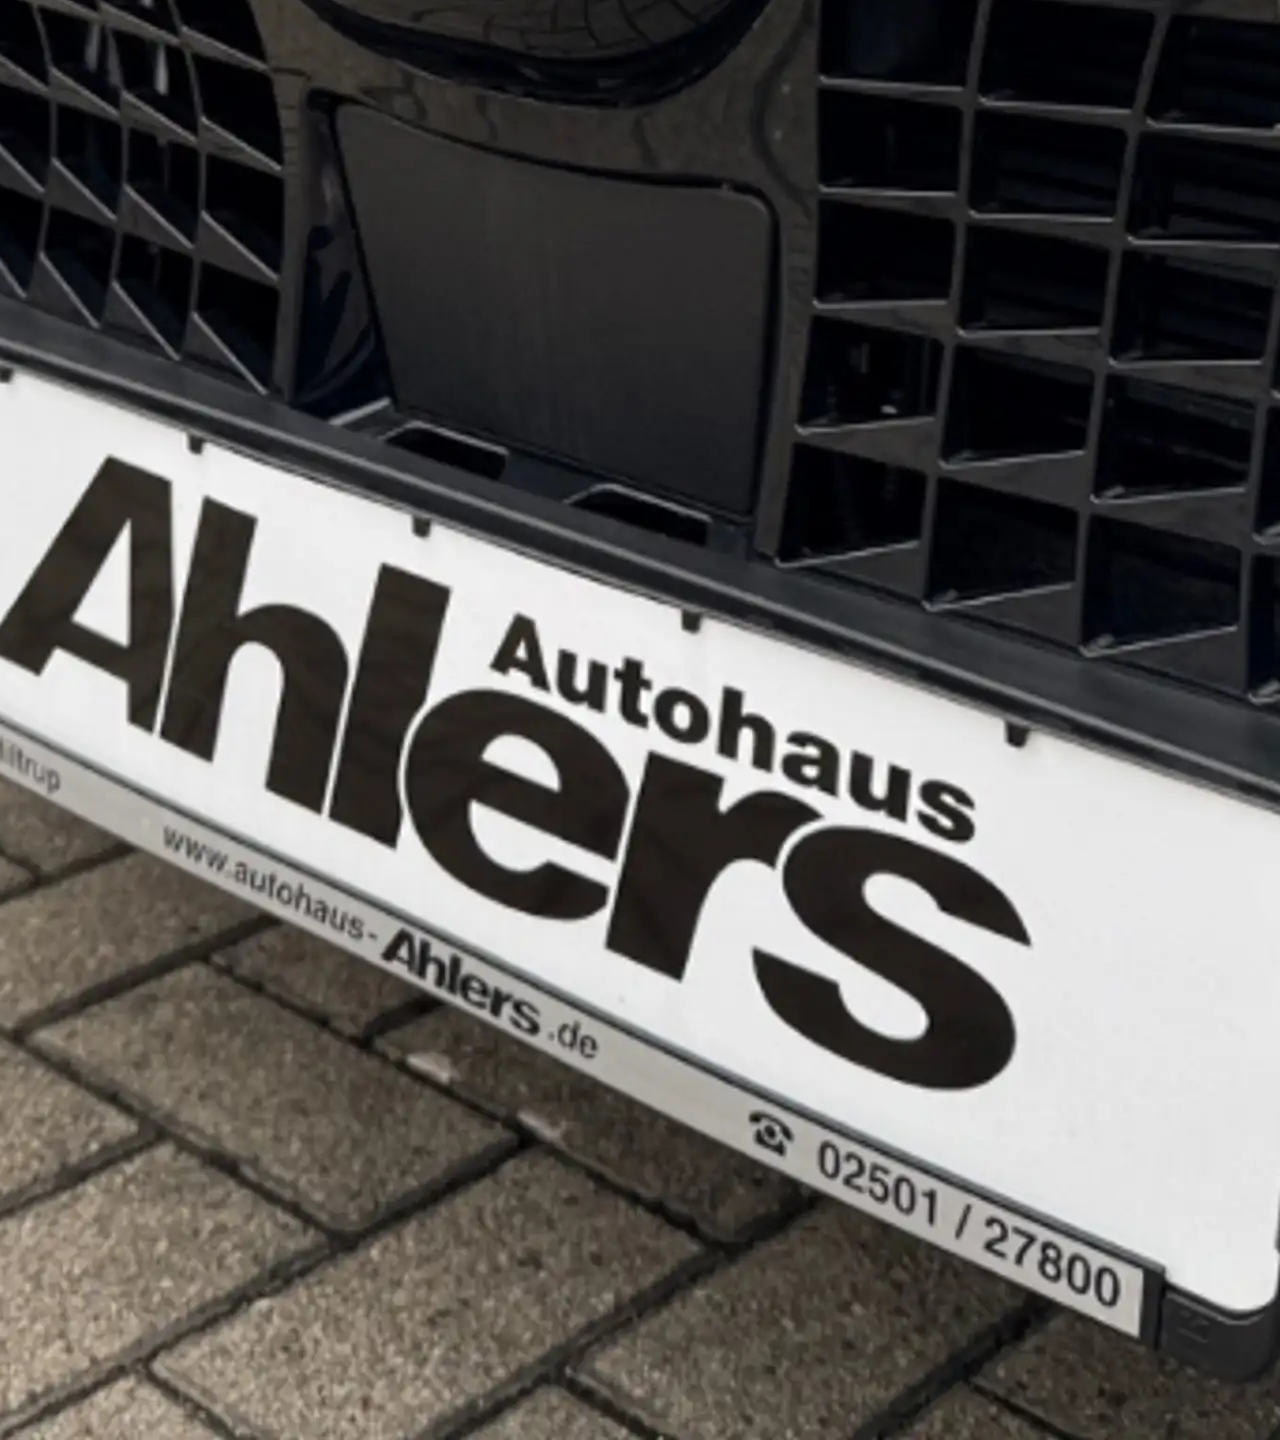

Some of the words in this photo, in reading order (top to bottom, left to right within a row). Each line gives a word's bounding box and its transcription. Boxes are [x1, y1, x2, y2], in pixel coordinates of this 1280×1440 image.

[491, 615, 974, 842] Autohaus
[818, 1140, 937, 1227] 02501
[954, 1203, 972, 1240] /
[982, 1217, 1121, 1309] 27800
